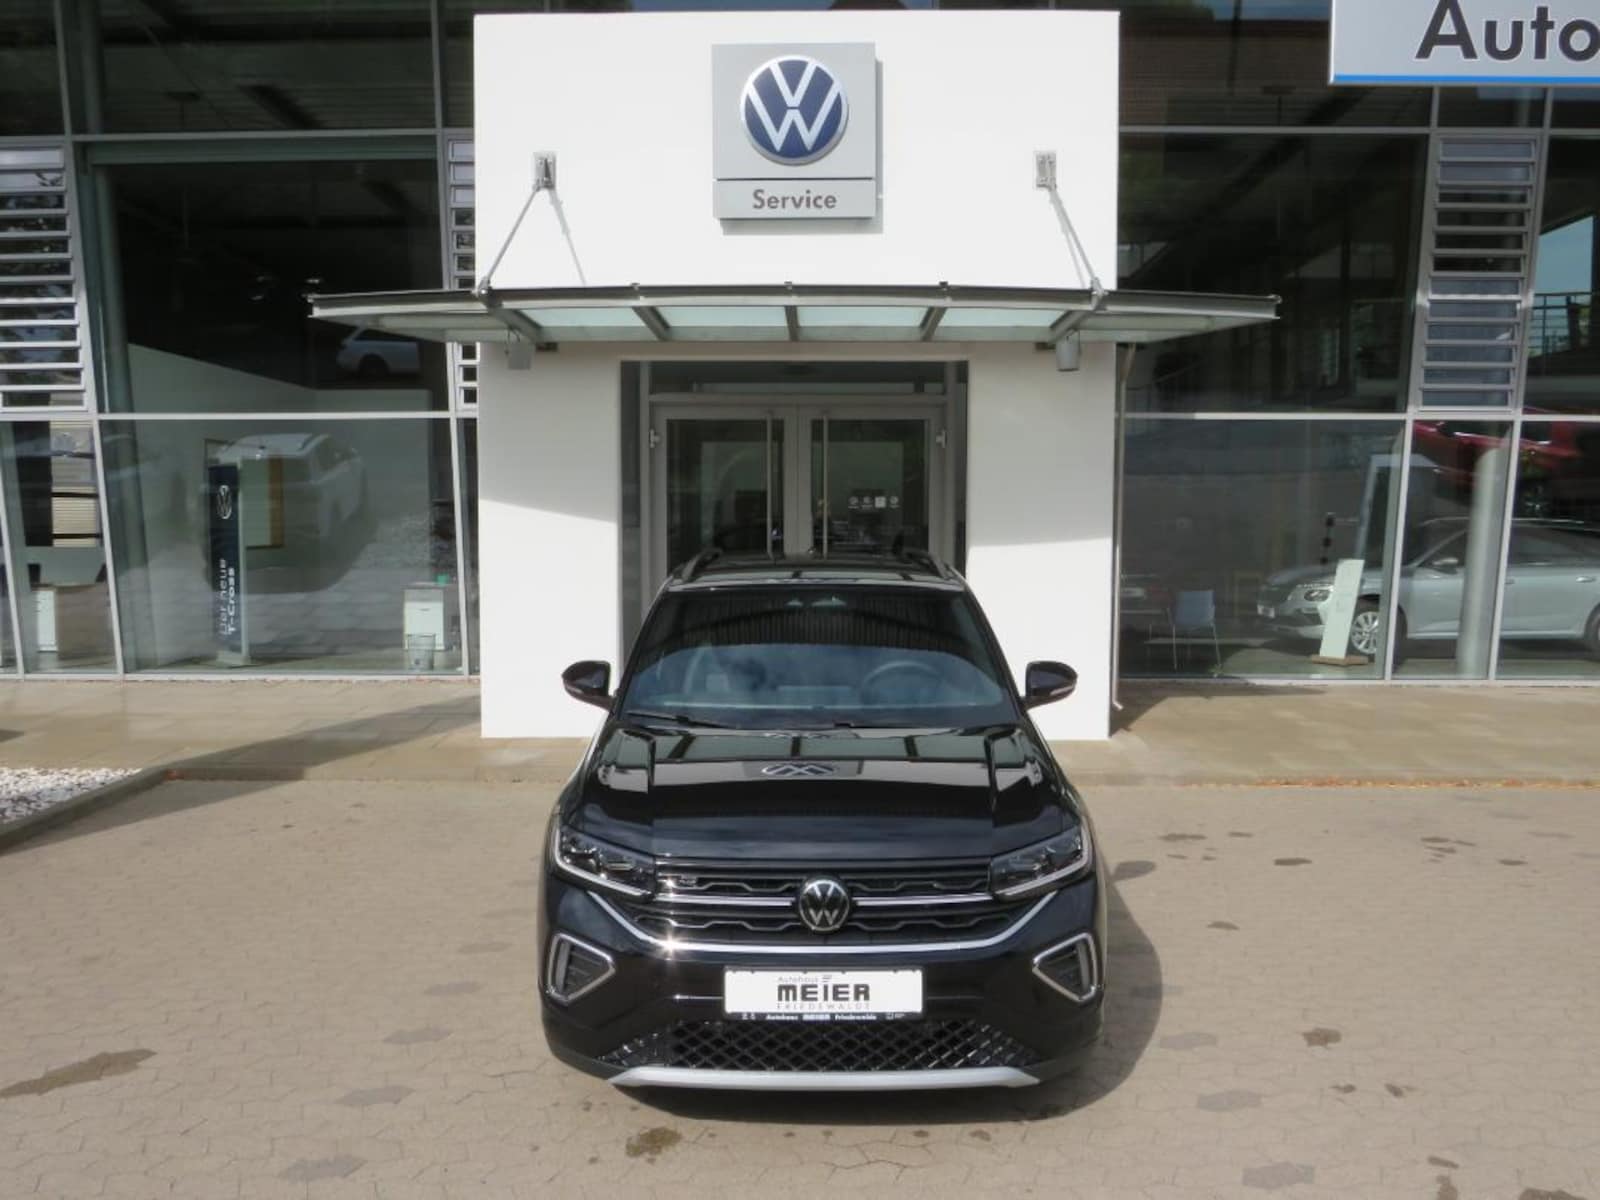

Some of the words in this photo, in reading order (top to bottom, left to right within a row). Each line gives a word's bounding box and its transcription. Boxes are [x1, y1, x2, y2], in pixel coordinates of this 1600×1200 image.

[1415, 0, 1600, 61] Auto
[752, 189, 837, 209] Service
[227, 567, 236, 635] T-Cross
[777, 984, 870, 1001] MEIER
